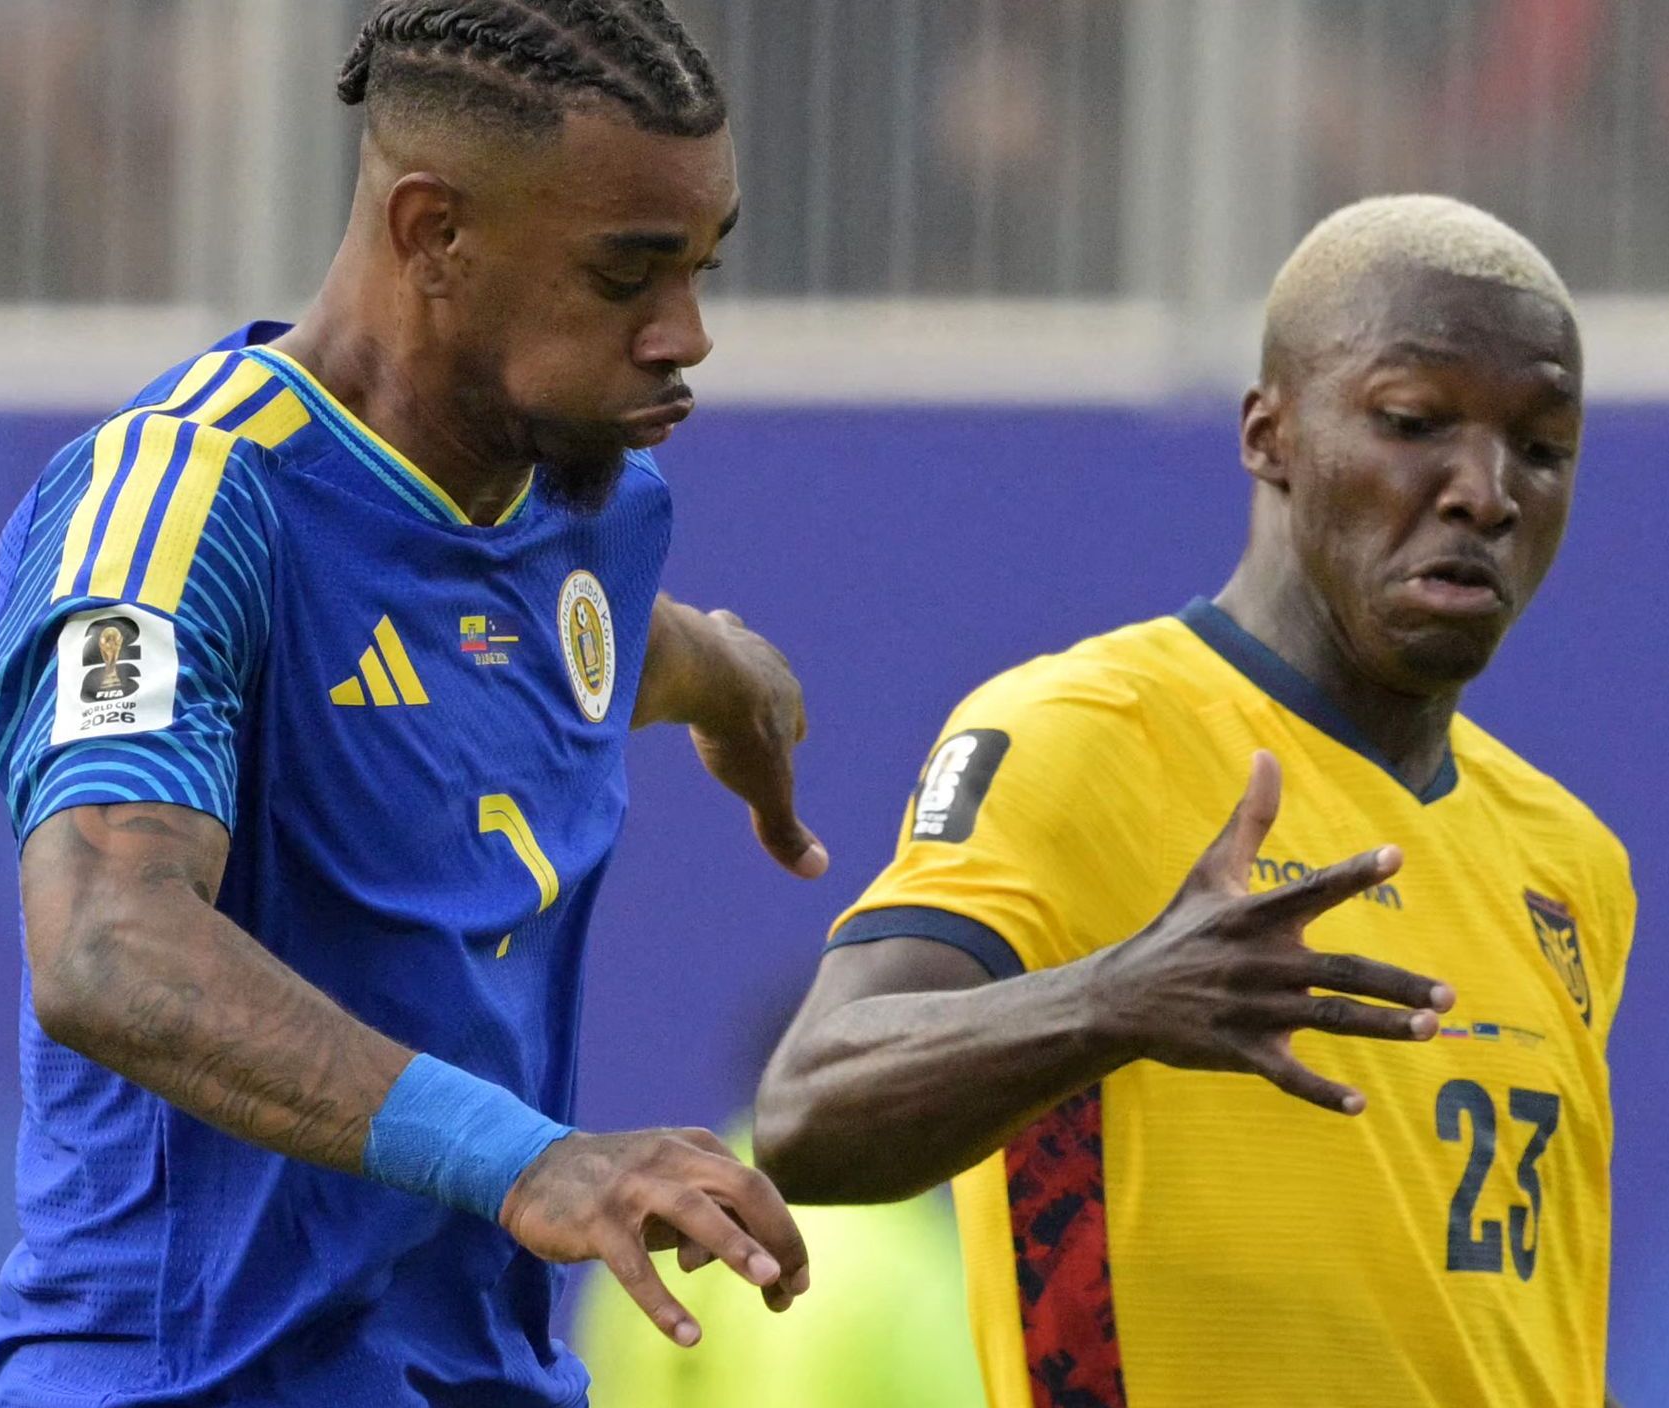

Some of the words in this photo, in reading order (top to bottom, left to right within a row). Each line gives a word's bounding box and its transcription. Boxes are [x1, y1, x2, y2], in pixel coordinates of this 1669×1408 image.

[95, 689, 124, 699] FIFA
[82, 703, 113, 718] WORLD
[116, 701, 136, 710] CUP
[80, 711, 136, 731] 2026
[1435, 1078, 1560, 1283] 23
